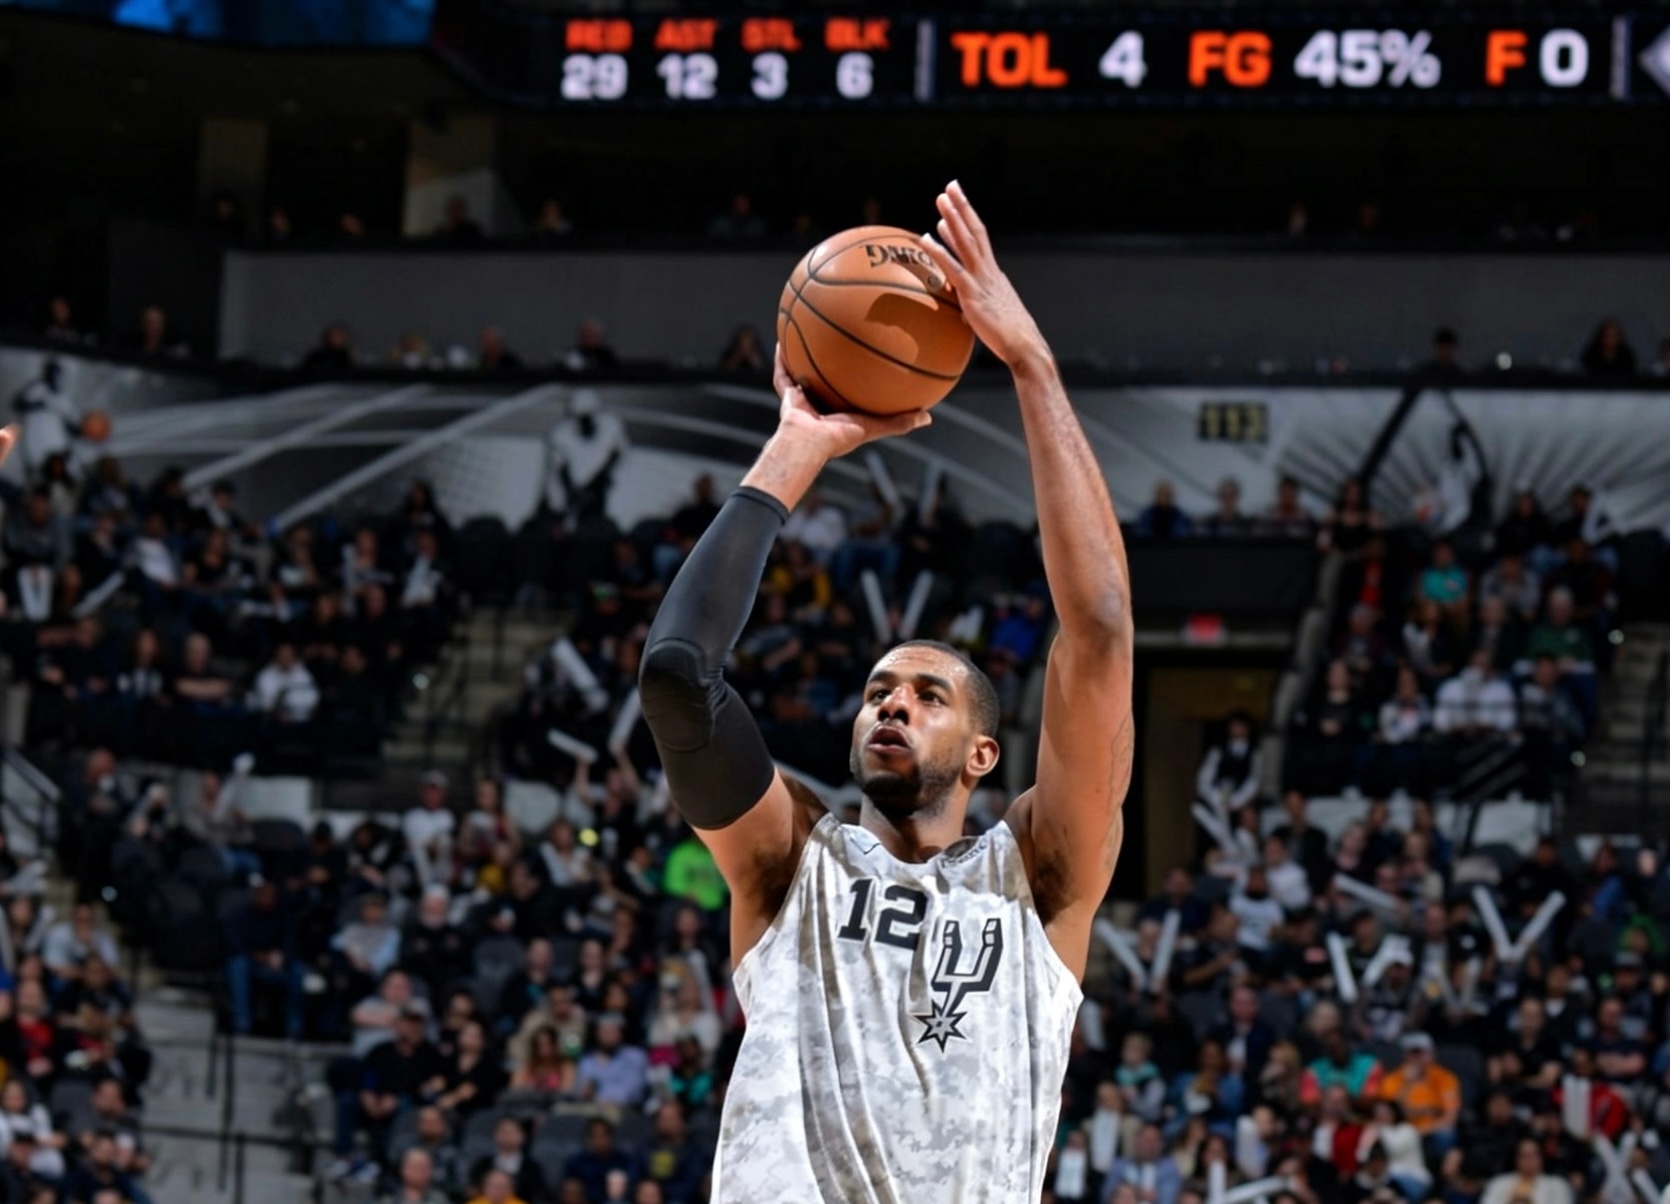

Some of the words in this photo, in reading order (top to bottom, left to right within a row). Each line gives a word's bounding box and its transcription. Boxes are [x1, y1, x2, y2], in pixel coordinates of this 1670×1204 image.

[655, 19, 718, 51] AST
[742, 18, 800, 51] STL
[825, 18, 889, 51] BLK
[951, 31, 1068, 87] TOL
[1099, 30, 1146, 87] 4
[1188, 30, 1272, 87] FG
[1294, 29, 1441, 87] 45%
[1485, 30, 1527, 85] F
[1540, 29, 1589, 87] 0
[561, 53, 628, 100] 29
[658, 53, 718, 99] 12
[752, 52, 788, 99] 3
[836, 52, 873, 99] 6
[837, 878, 928, 952] 12
